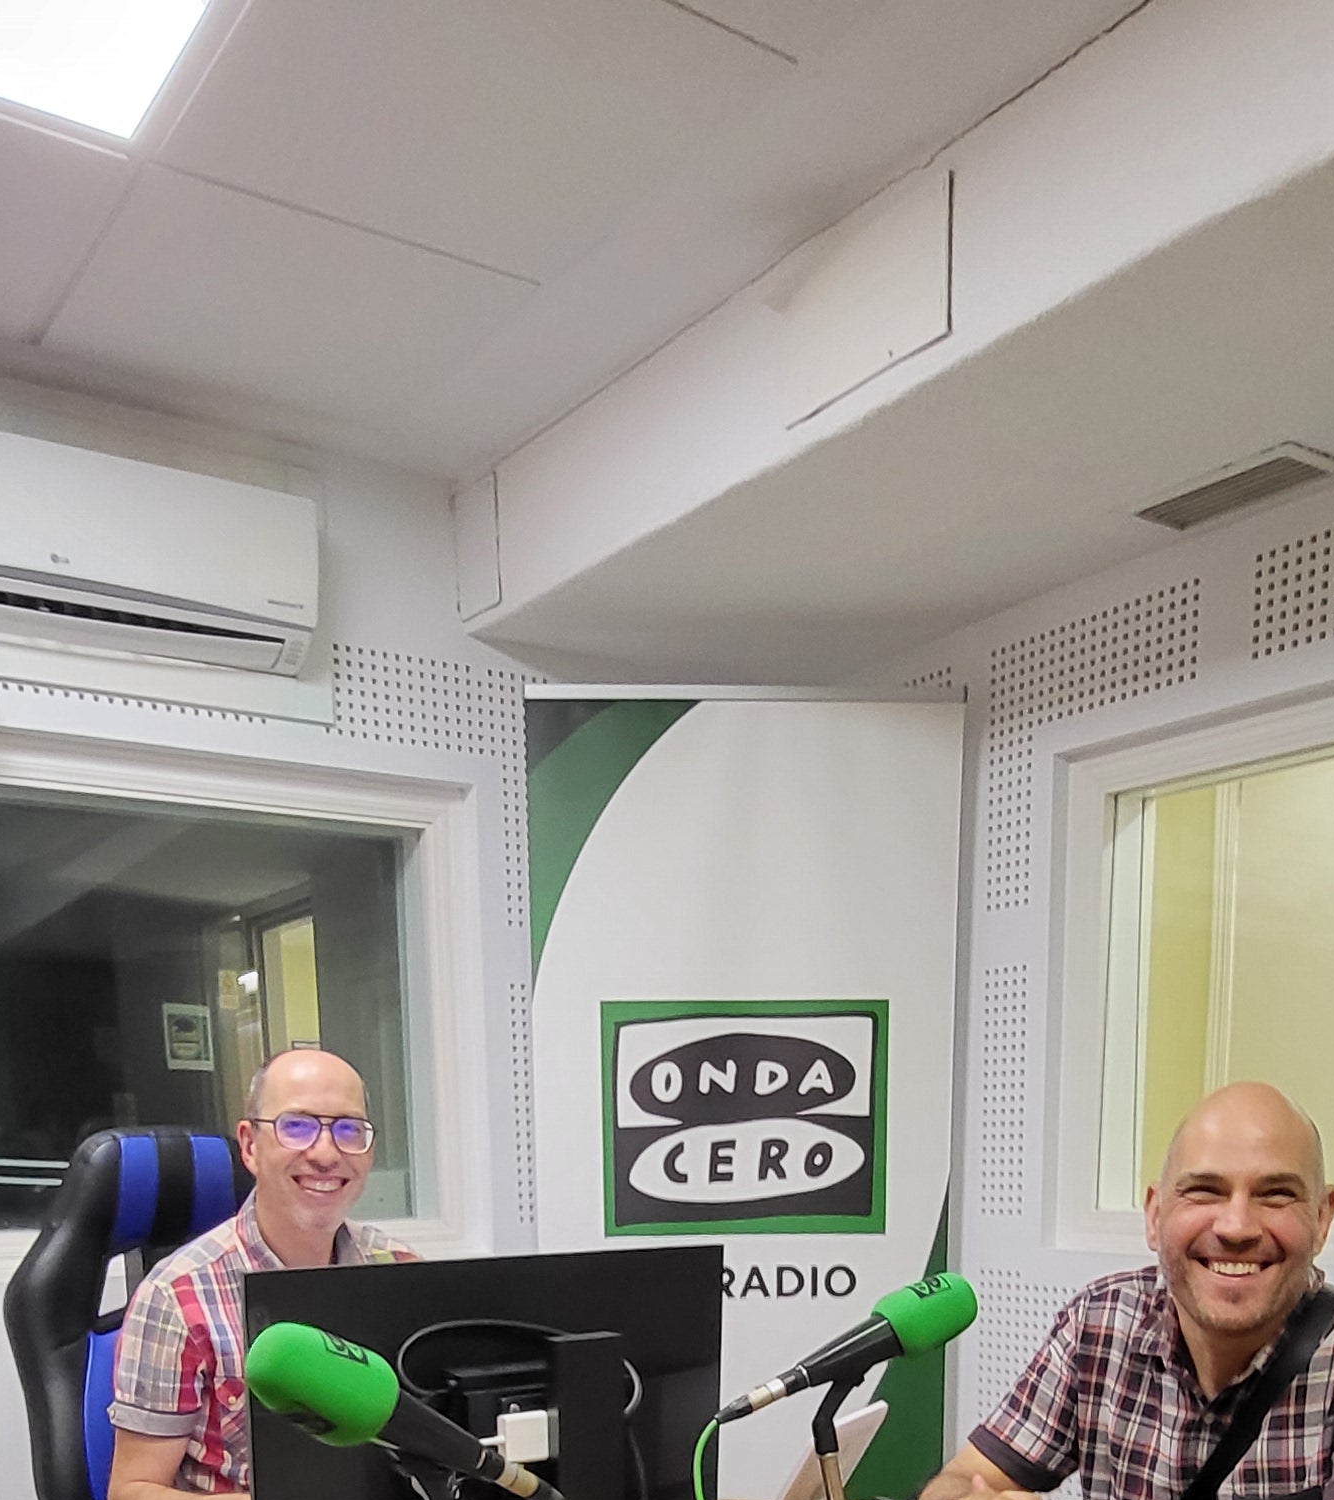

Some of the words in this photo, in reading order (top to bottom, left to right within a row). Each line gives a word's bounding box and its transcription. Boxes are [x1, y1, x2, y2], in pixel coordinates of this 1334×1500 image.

[650, 1058, 834, 1103] ONDA
[663, 1138, 833, 1183] CERO
[722, 1265, 857, 1299] RADIO
